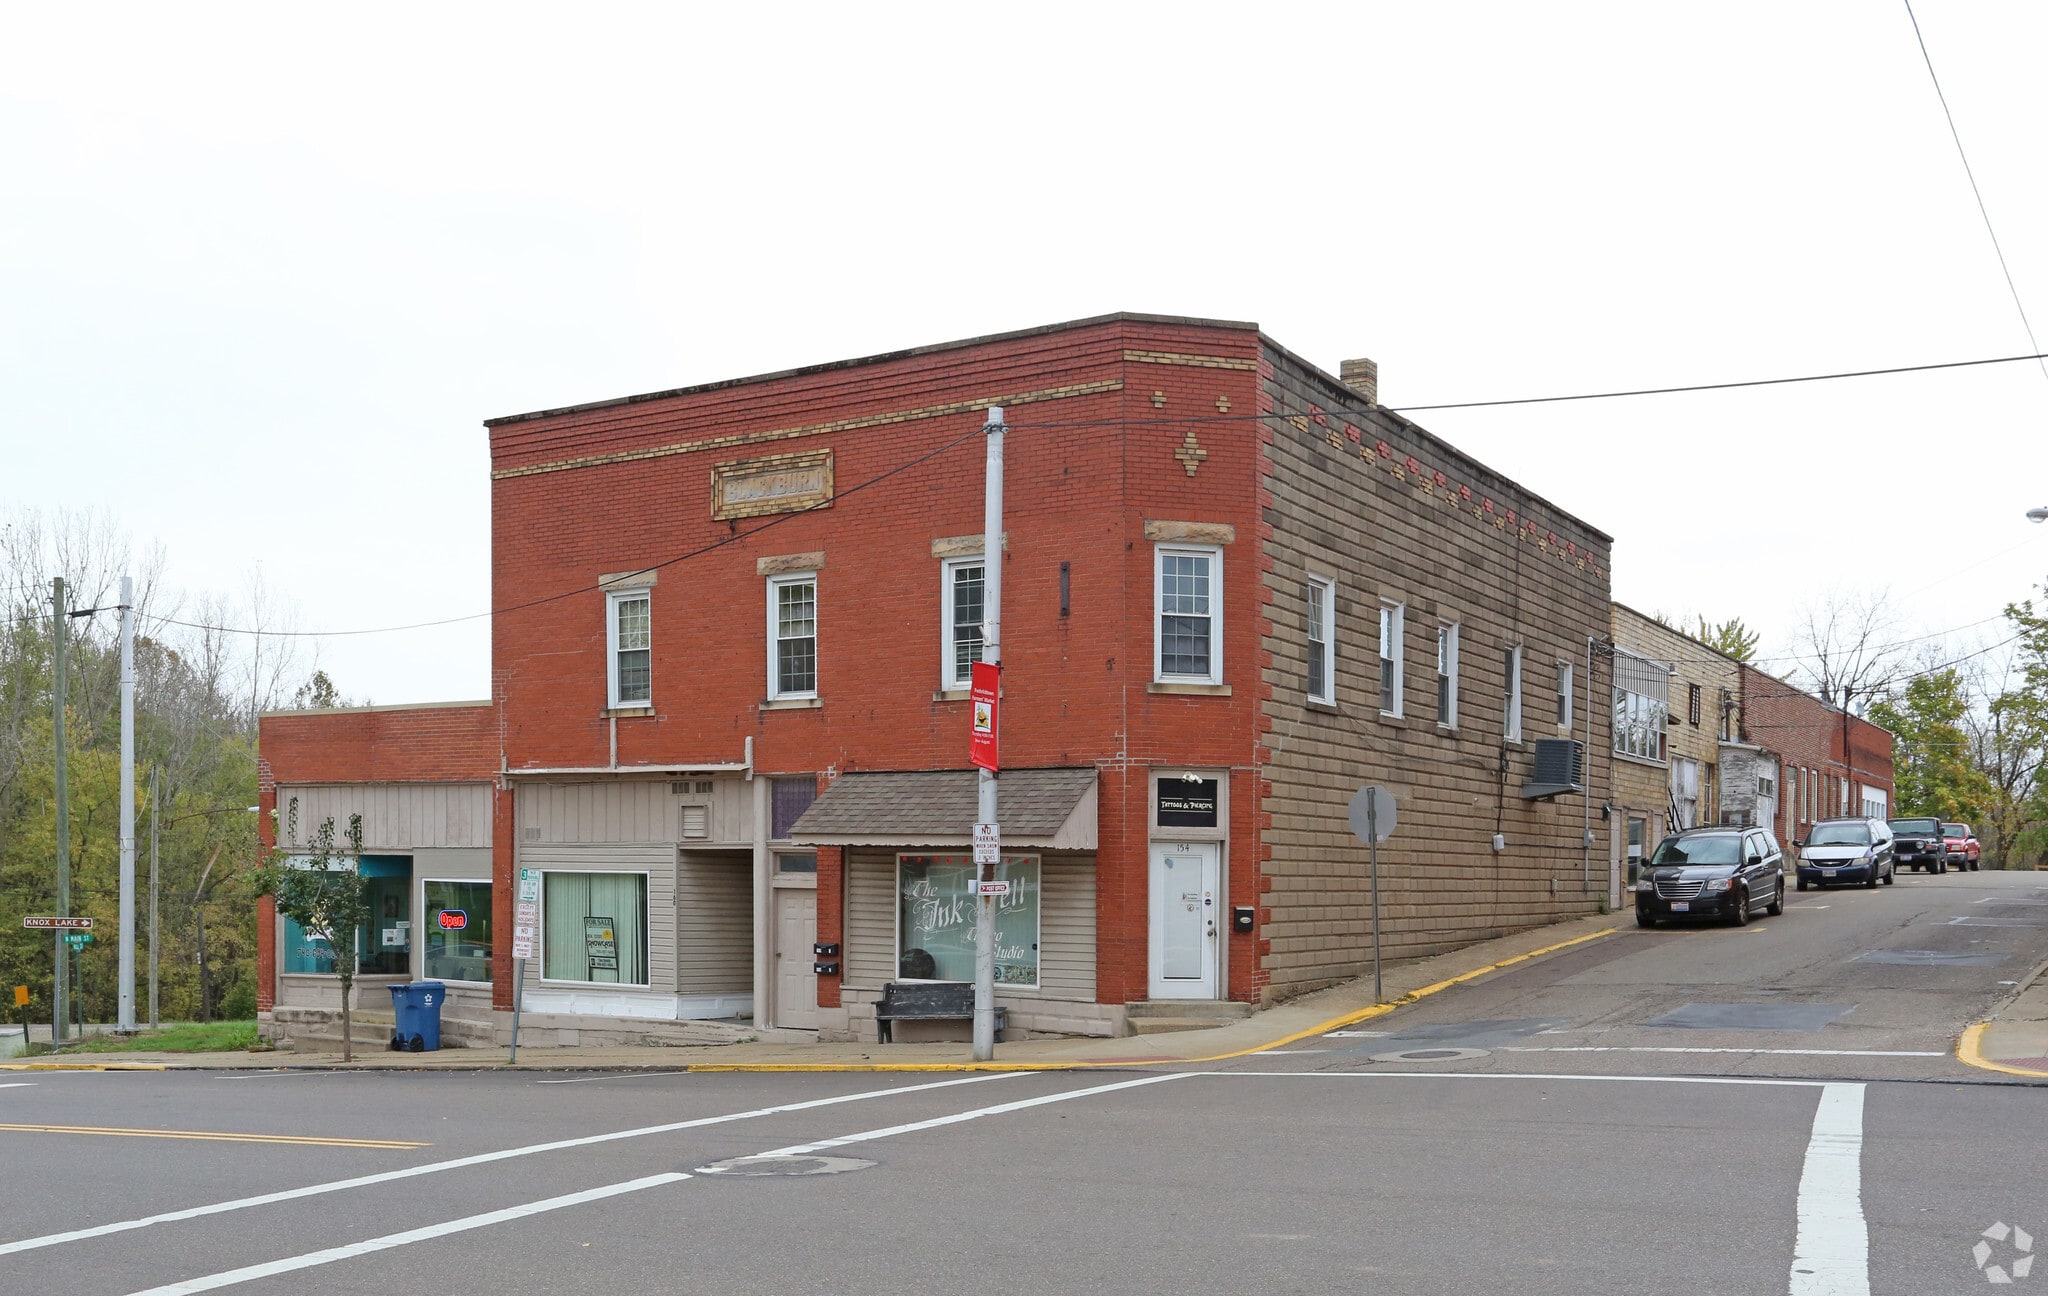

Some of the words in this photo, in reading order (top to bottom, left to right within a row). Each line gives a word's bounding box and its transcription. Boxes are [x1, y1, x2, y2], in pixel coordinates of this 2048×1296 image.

[981, 826, 991, 835] NO
[1177, 844, 1190, 852] 154
[522, 871, 527, 879] 3
[911, 880, 938, 898] The
[919, 893, 964, 930] Ink
[440, 912, 464, 929] Open
[585, 918, 597, 927] FOR
[597, 919, 611, 927] SALE
[520, 927, 529, 935] NO
[994, 944, 1024, 960] tudio
